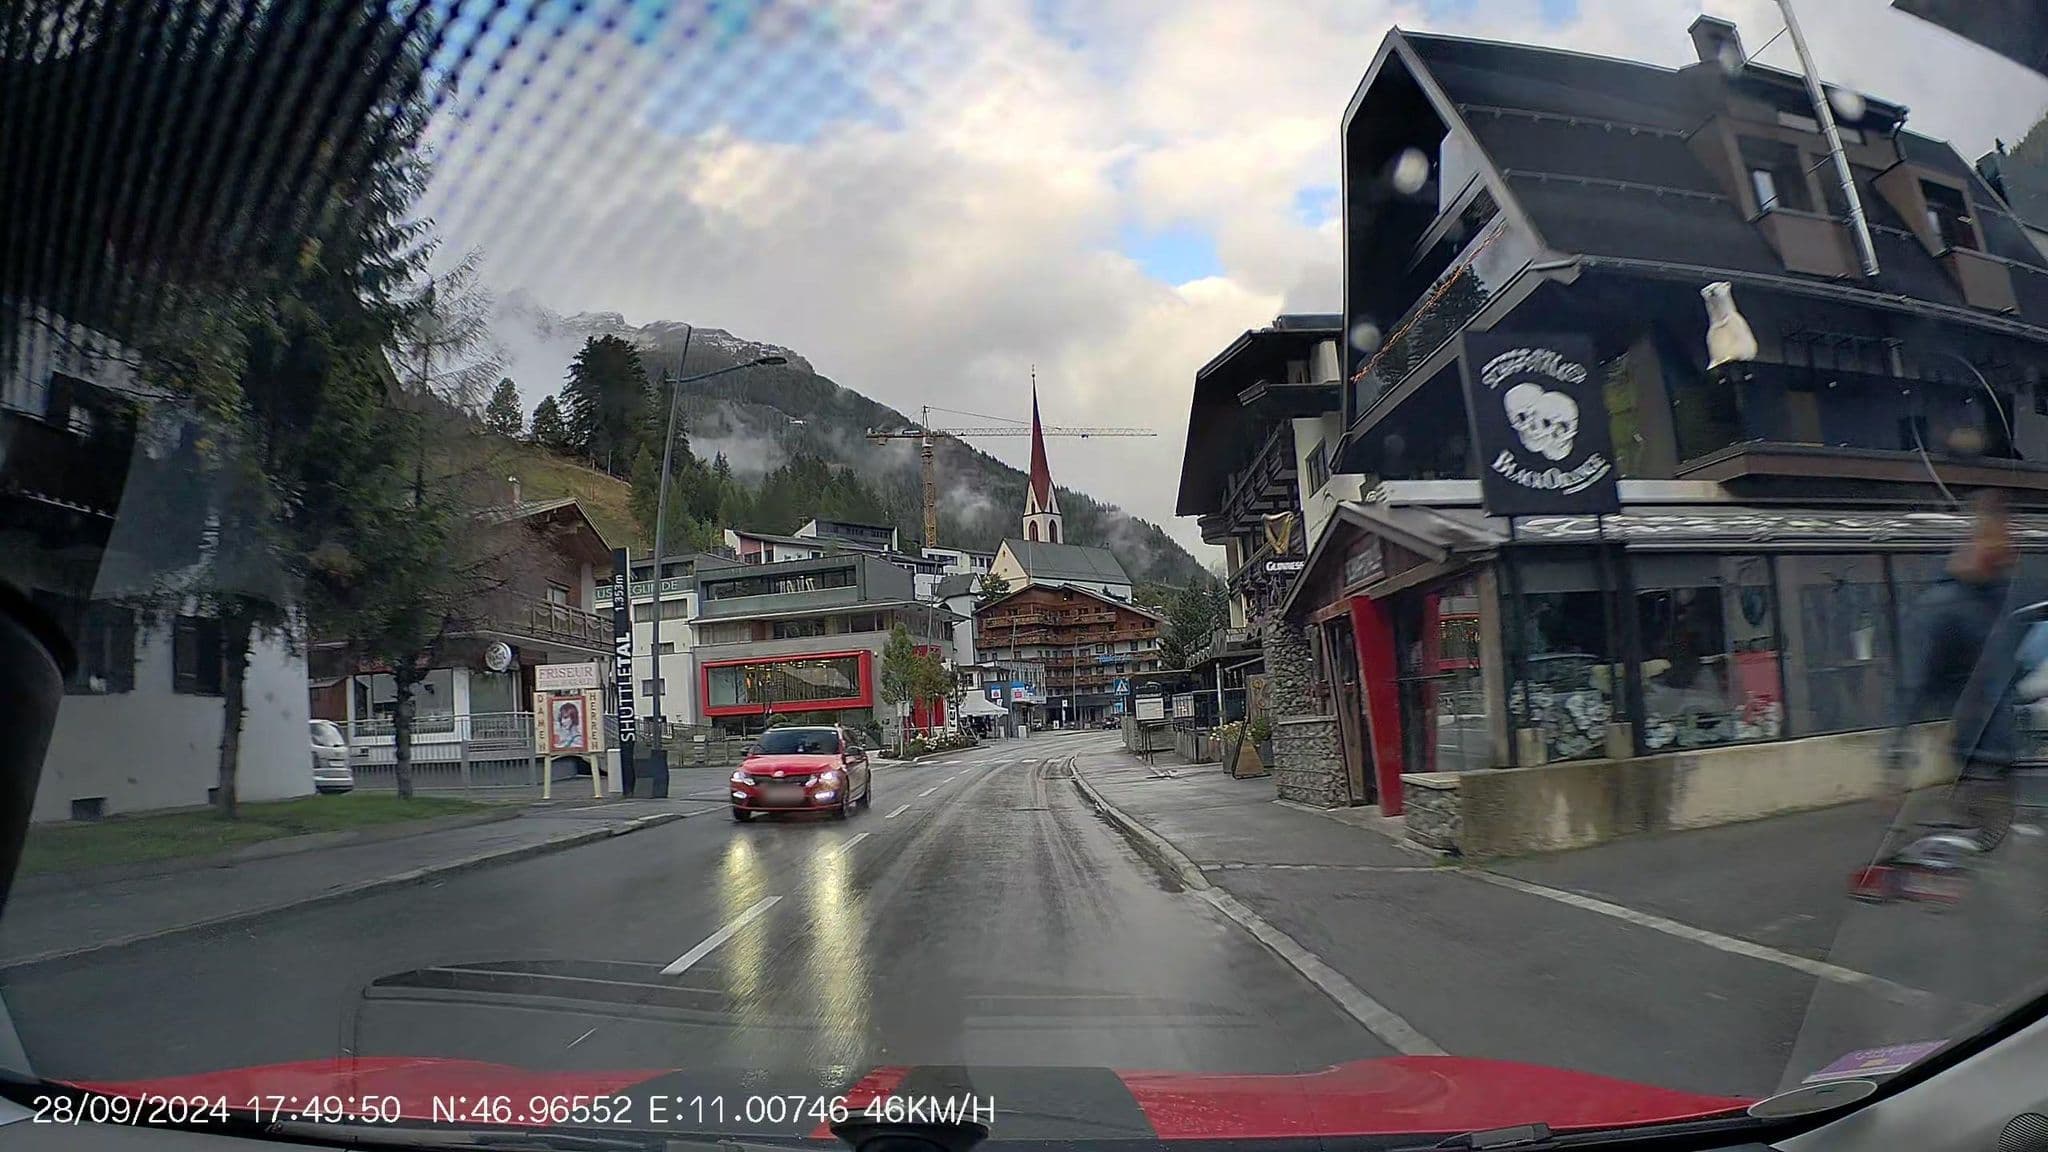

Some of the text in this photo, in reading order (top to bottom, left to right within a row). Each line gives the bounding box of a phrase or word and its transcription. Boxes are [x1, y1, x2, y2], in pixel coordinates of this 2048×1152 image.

[597, 588, 613, 599] US
[538, 666, 593, 680] FRISEUR
[616, 632, 635, 742] SHUTTLETAL
